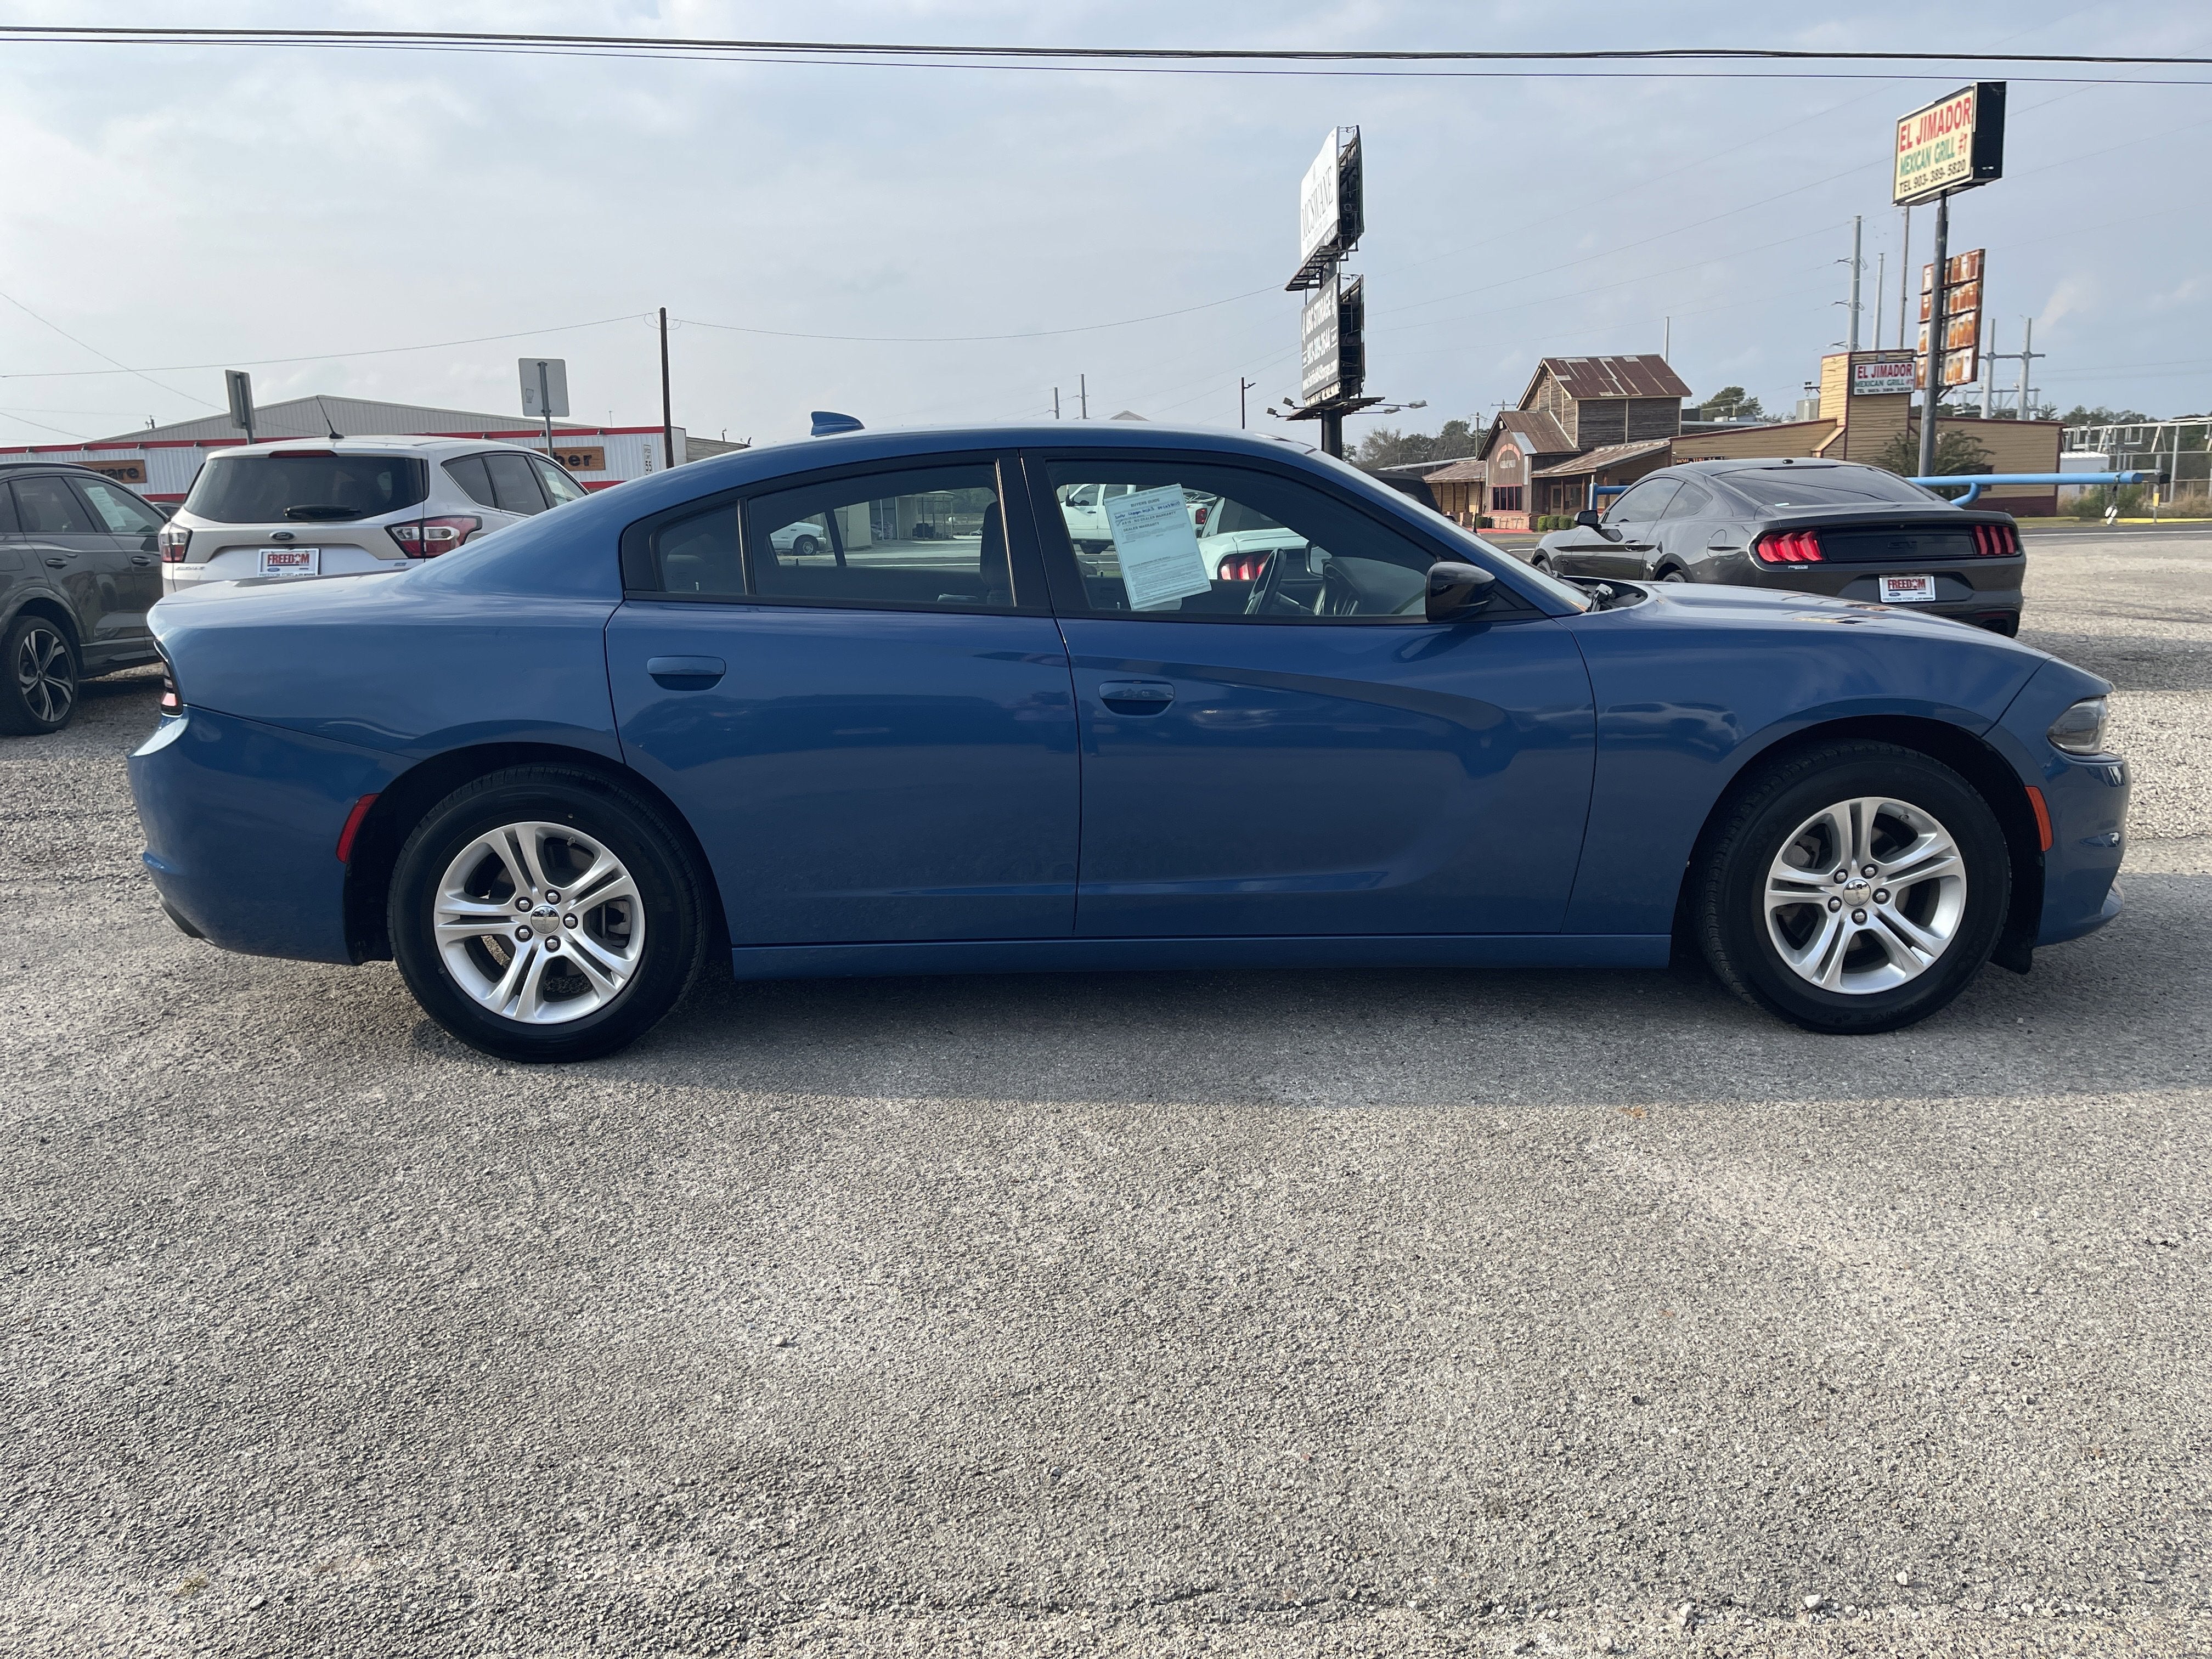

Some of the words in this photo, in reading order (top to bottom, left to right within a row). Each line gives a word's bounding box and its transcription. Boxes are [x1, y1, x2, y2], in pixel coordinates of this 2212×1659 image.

[1900, 123, 1913, 152] EL
[1916, 97, 1972, 145] JIMADOR
[1899, 145, 1932, 178] MEXICAN
[1934, 137, 1955, 164] GRILL
[1899, 179, 1911, 194] TEL
[1313, 289, 1331, 329] STORAGE
[1858, 366, 1868, 379] EL
[1871, 364, 1912, 377] JIMADOR
[645, 460, 652, 472] 55
[268, 554, 309, 564] FREEDOM
[1887, 579, 1925, 589] FREEDOM
